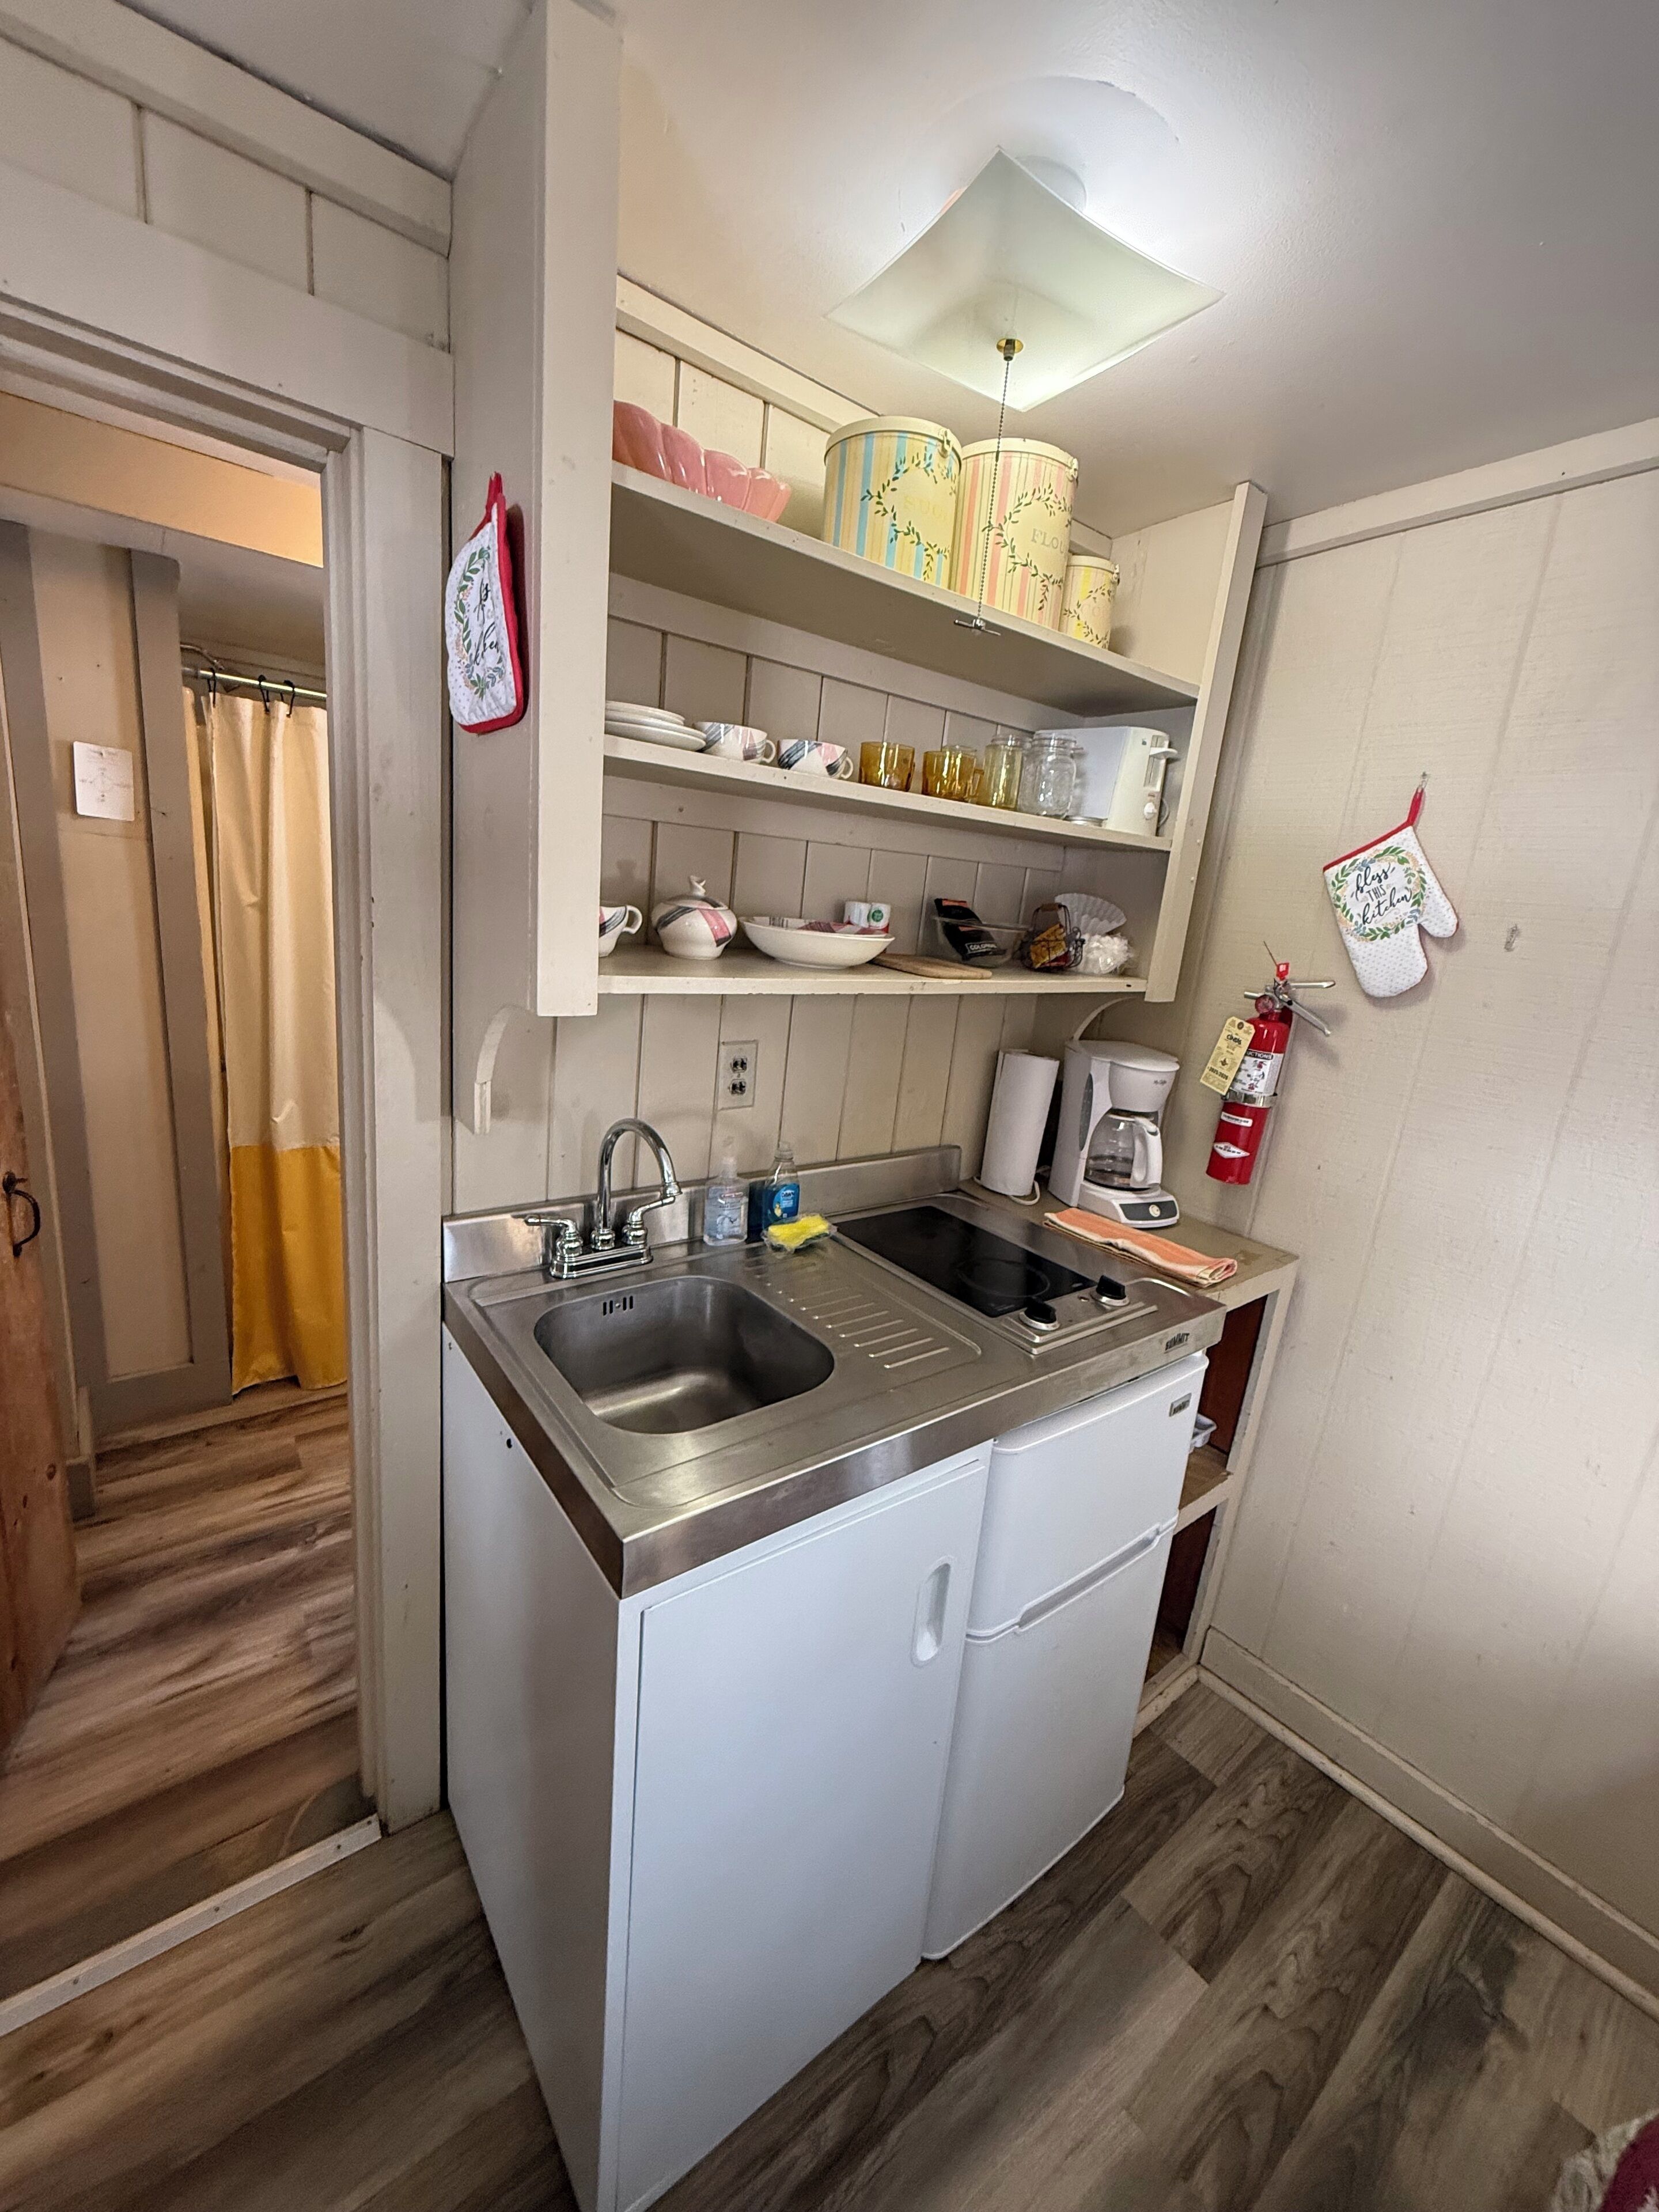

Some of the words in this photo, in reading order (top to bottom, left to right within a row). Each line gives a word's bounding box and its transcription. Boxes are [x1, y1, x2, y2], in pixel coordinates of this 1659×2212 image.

[1355, 862, 1391, 902] bless
[1366, 884, 1387, 902] THIS
[1362, 887, 1412, 925] kitchen
